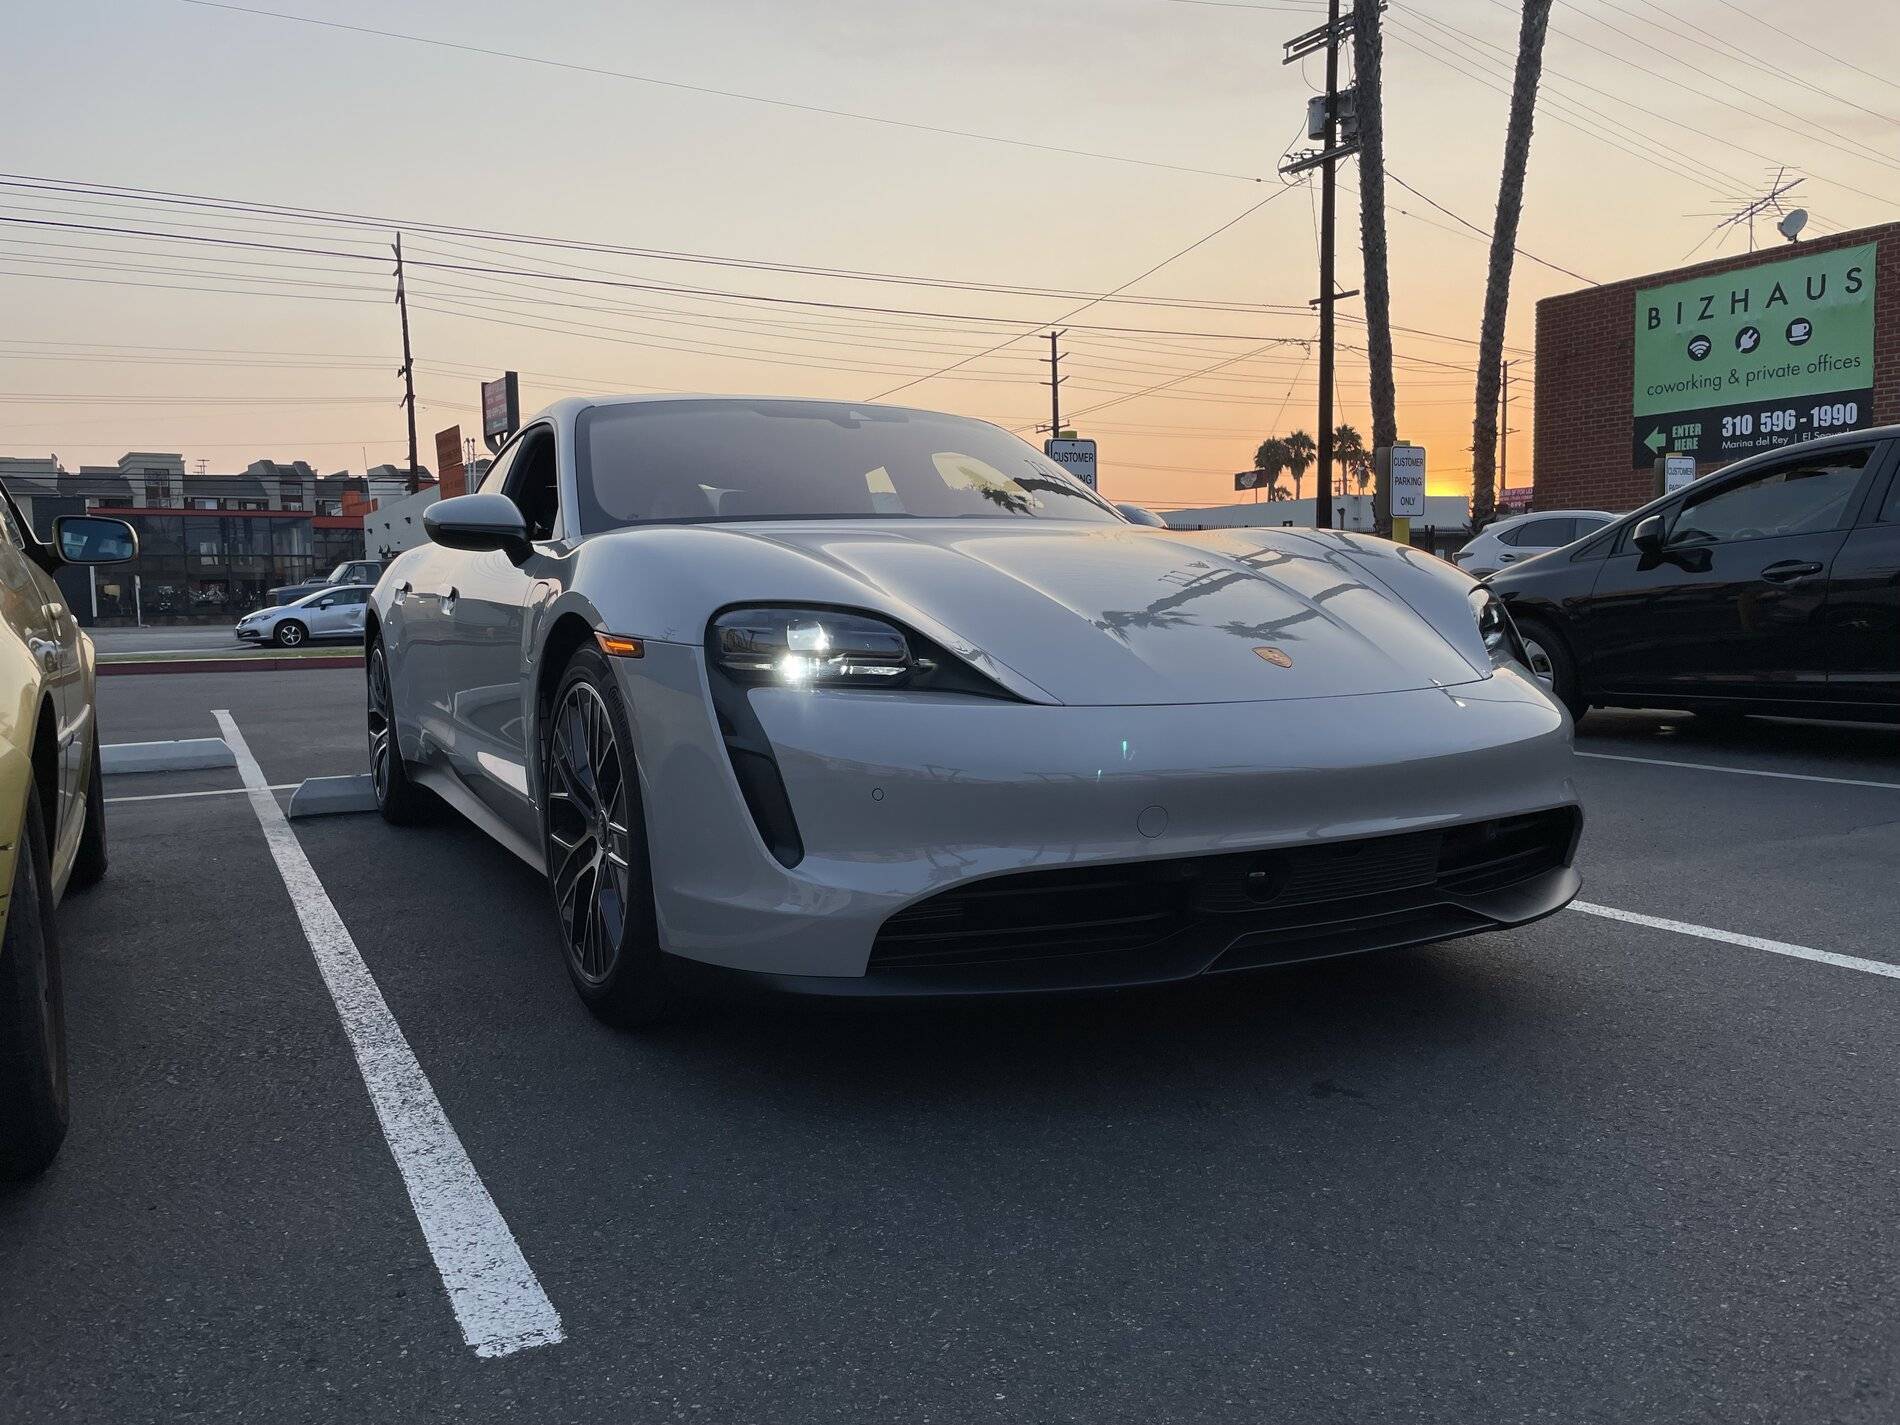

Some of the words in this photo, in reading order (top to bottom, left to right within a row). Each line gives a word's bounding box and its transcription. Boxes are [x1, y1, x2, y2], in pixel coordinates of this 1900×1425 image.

[1647, 267, 1863, 330] BIZHAUS
[1647, 373, 1722, 397] coworking
[1728, 369, 1740, 385] &
[1746, 363, 1801, 389] private
[1807, 353, 1861, 375] offices
[1722, 414, 1753, 437] 310
[1760, 409, 1796, 433] 596
[1810, 402, 1858, 428] 1990
[1672, 423, 1702, 437] ENTER
[1674, 437, 1699, 451] HERE
[1722, 439, 1753, 450] Marina
[1756, 436, 1770, 447] del
[1773, 436, 1789, 446] Rey
[1803, 432, 1811, 442] El
[1053, 451, 1094, 463] CUSTOMER
[1393, 457, 1424, 467] CUSTOMER
[1668, 467, 1694, 476] CUSTOMER
[1394, 476, 1423, 486] PARKING
[1400, 496, 1416, 506] ONLY
